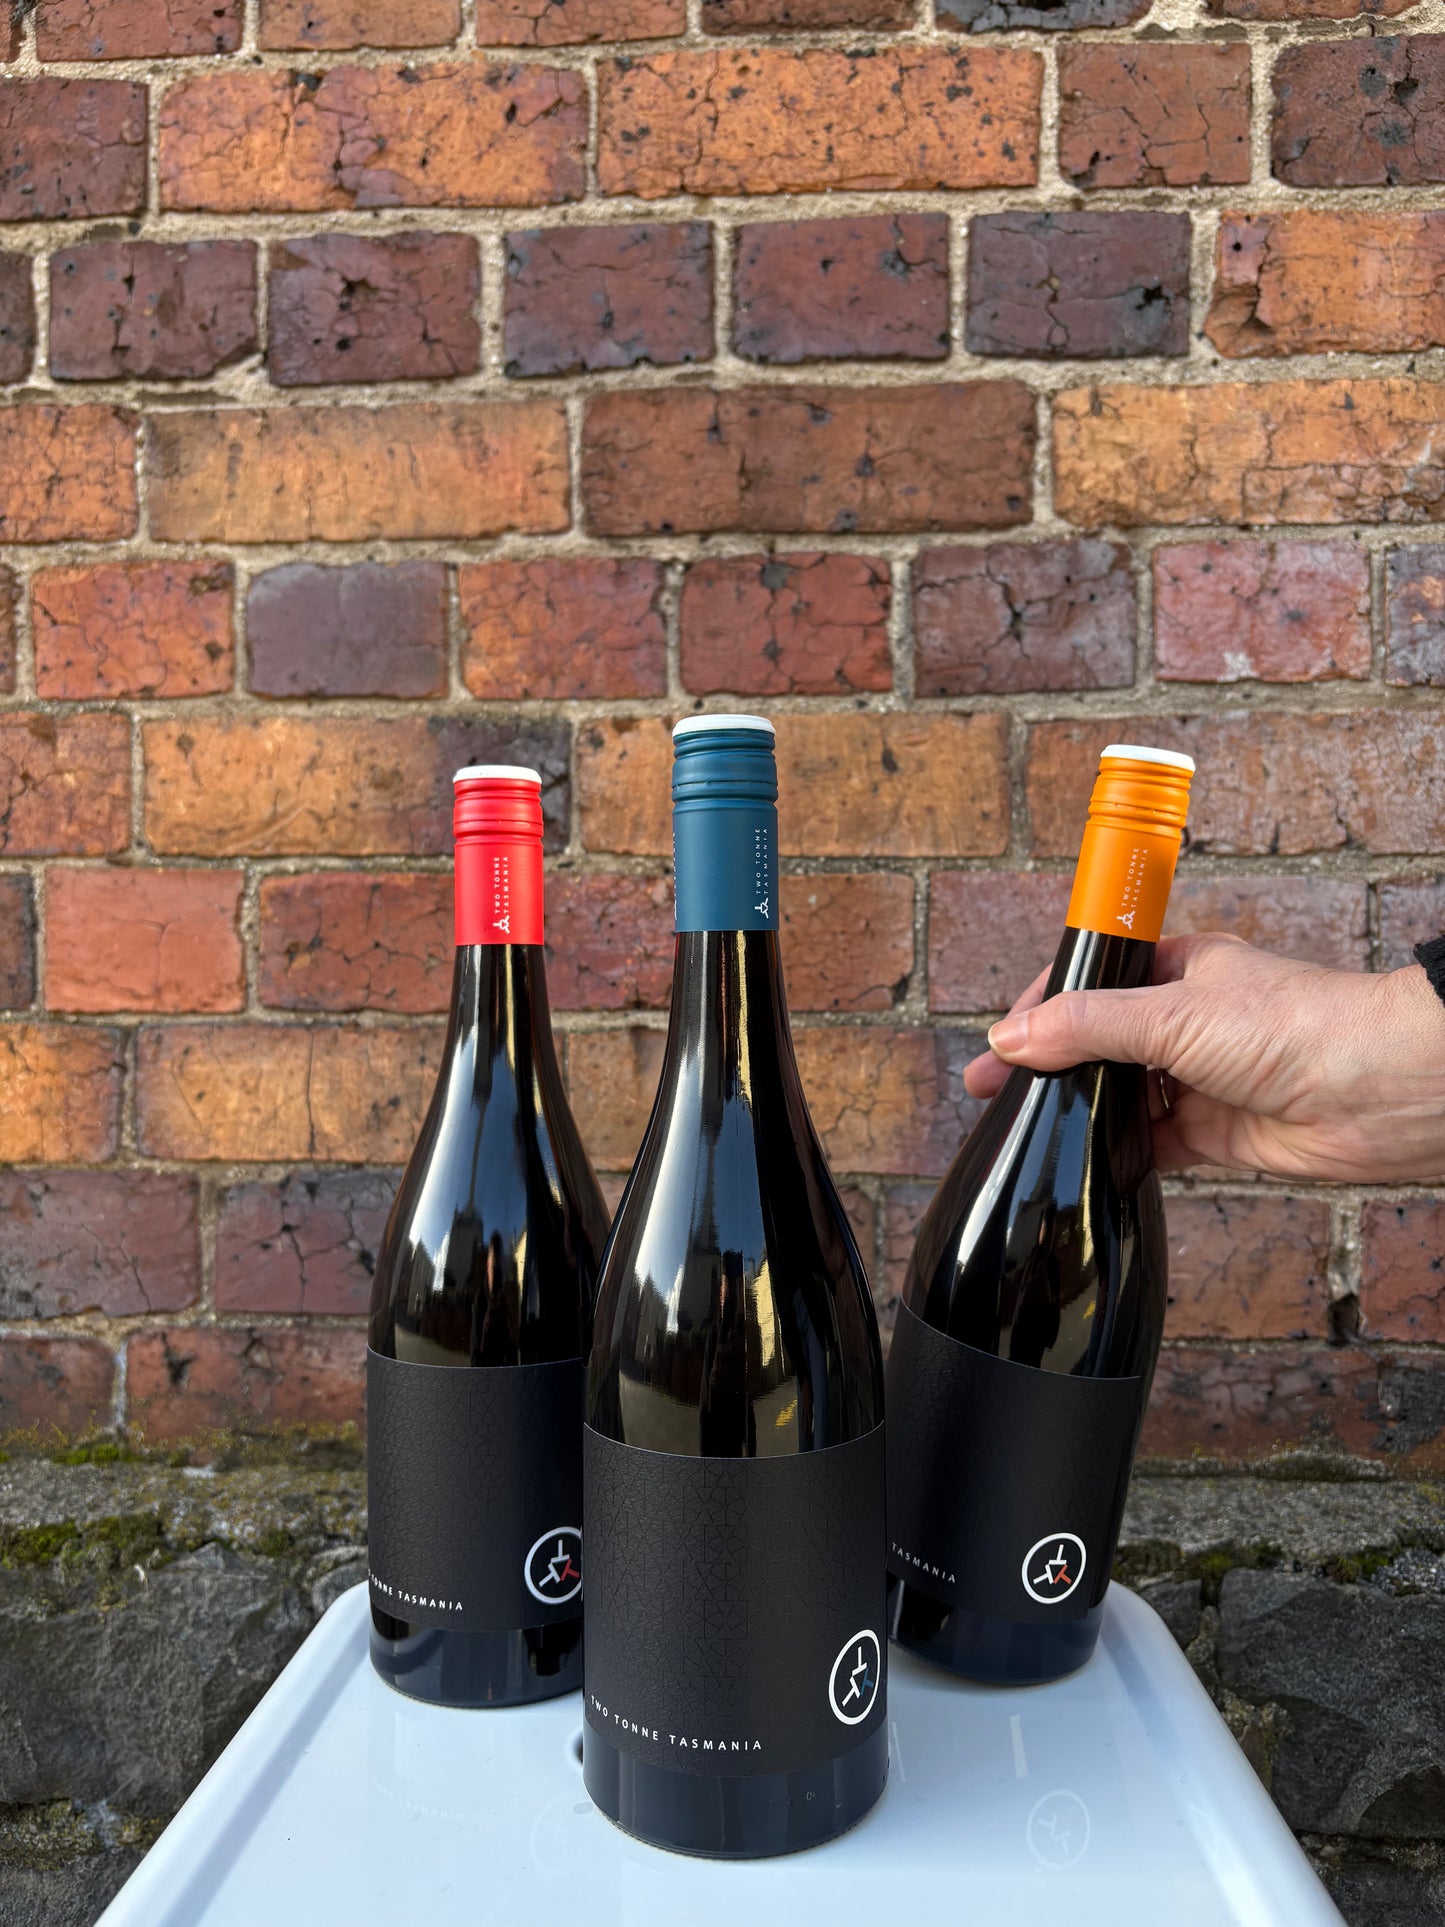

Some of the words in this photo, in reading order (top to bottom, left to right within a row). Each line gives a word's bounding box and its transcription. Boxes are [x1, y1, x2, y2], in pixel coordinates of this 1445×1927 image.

[1121, 886, 1131, 907] TWO
[1127, 847, 1139, 880] TONNE
[1130, 849, 1148, 908] TASMANIA
[892, 1541, 956, 1584] TASMANIA
[398, 1590, 463, 1611] TASMANIA
[590, 1695, 609, 1718] TWO
[614, 1714, 659, 1741] TONNE
[669, 1734, 762, 1751] TASMANIA
